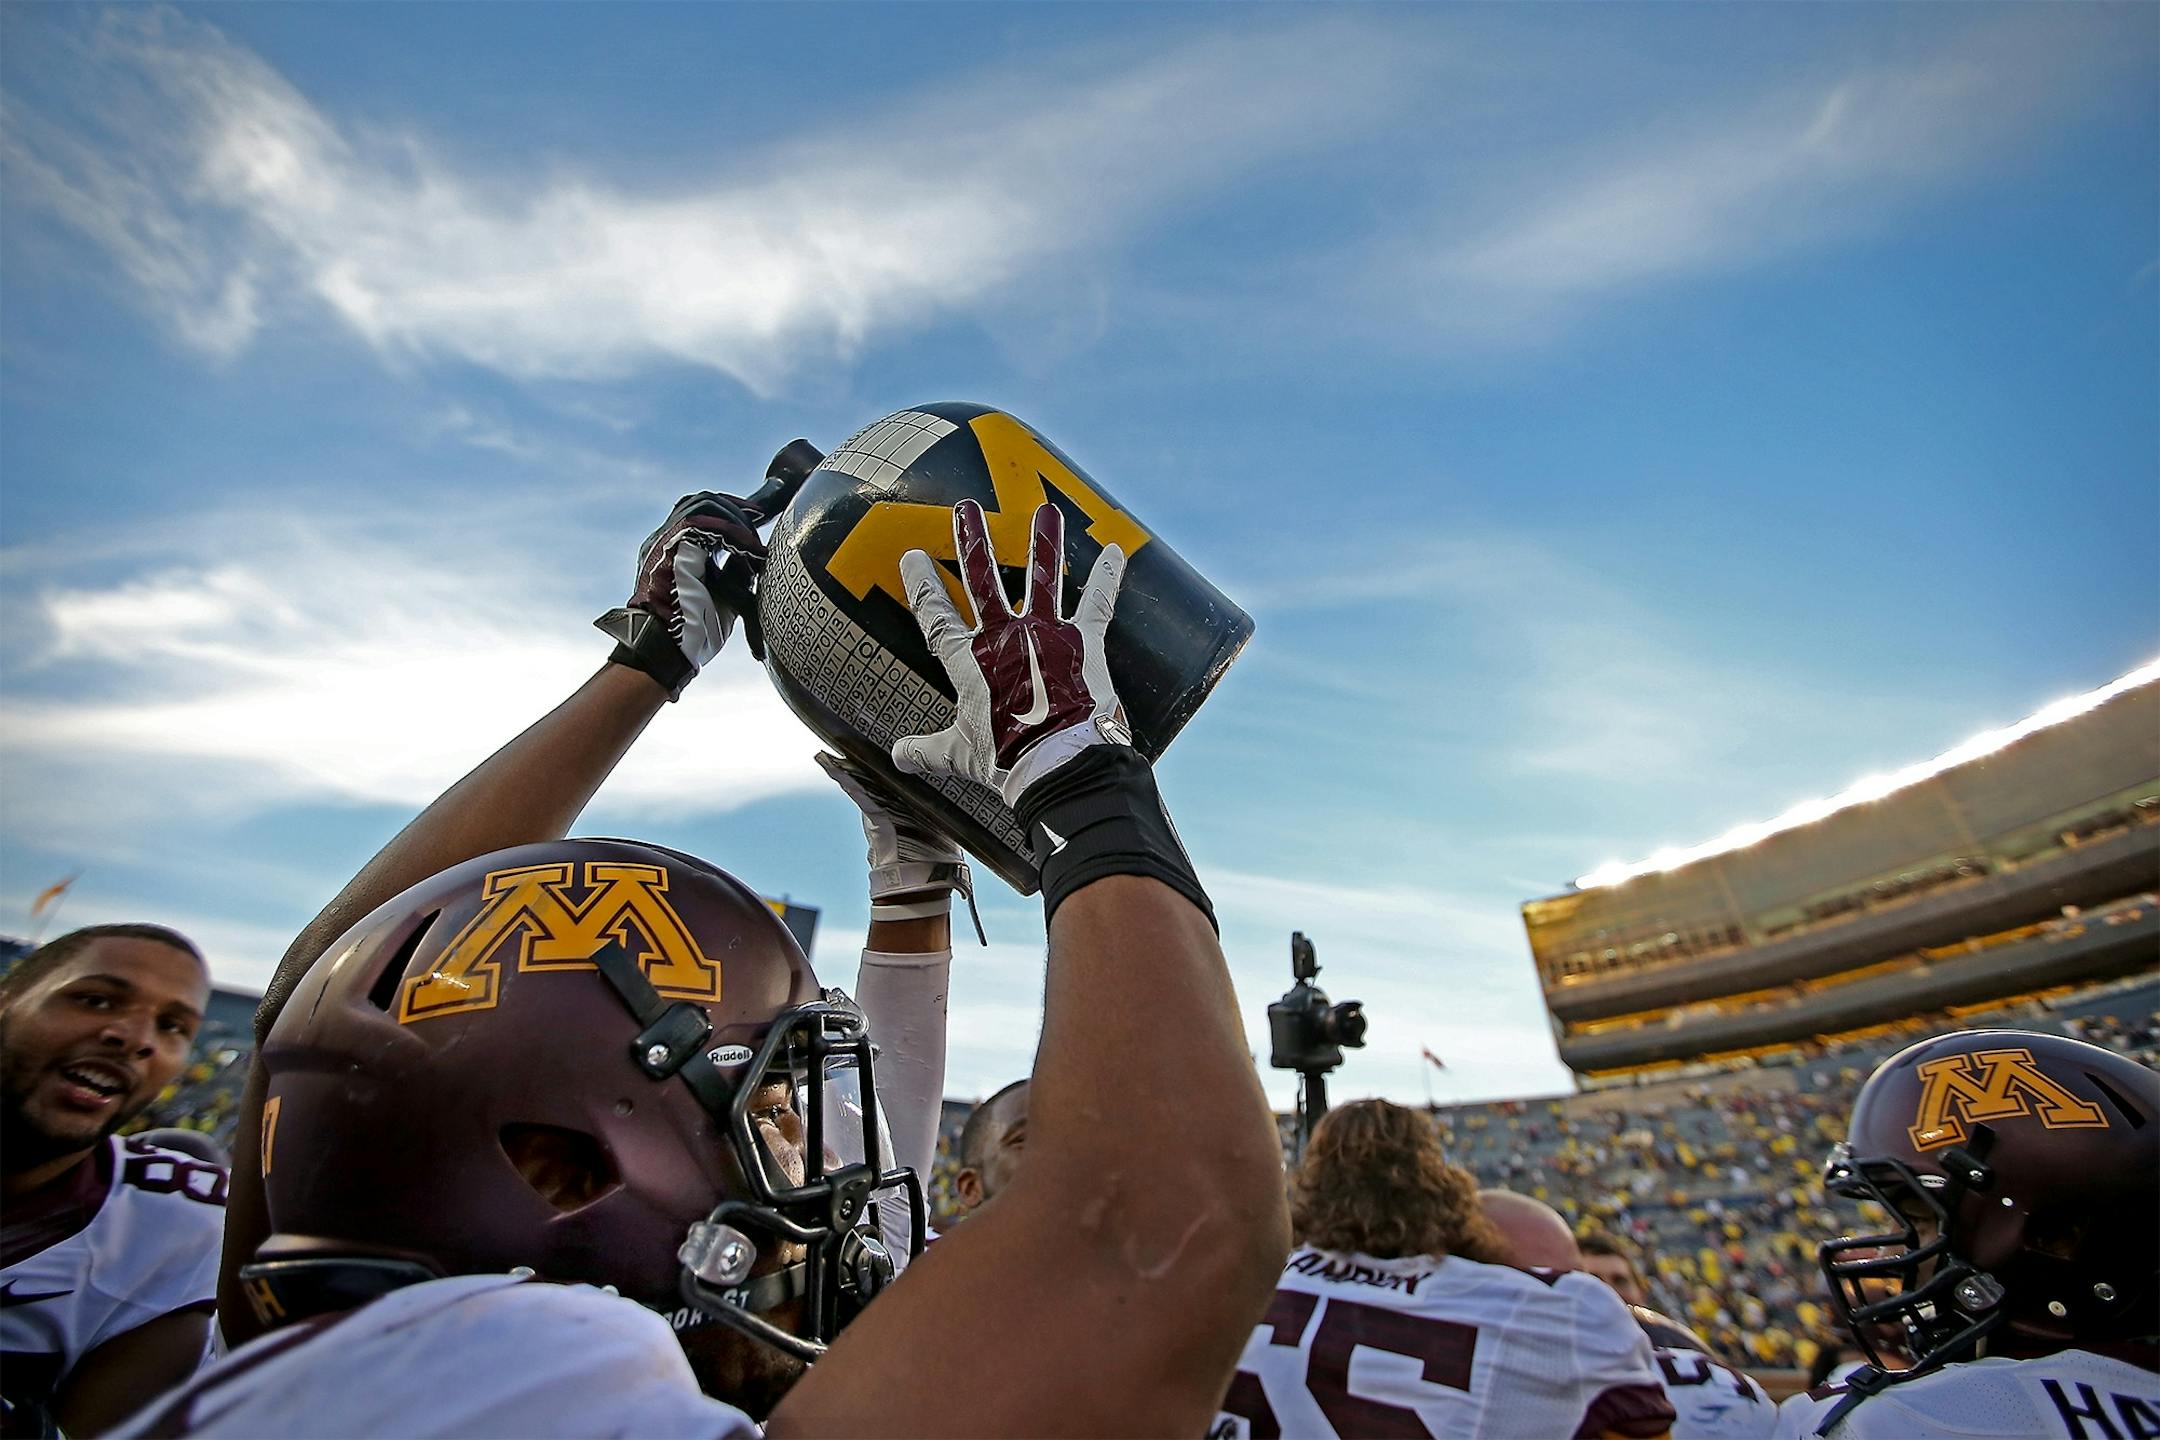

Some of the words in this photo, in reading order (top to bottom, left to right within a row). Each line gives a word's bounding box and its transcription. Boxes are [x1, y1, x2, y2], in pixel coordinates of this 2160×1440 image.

[788, 562, 798, 578] 0
[775, 596, 794, 634] 1967
[793, 575, 809, 595] 20
[784, 613, 805, 648] 1968
[803, 590, 820, 612] 20
[795, 626, 815, 660] 1969
[817, 607, 829, 621] 9
[800, 667, 813, 686] 39
[808, 635, 830, 671] 1970
[828, 619, 844, 636] 13
[859, 641, 873, 658] 0
[874, 654, 887, 669] 7
[813, 682, 828, 700] 35
[821, 653, 843, 685] 1971
[843, 631, 857, 643] 7
[835, 665, 859, 695] 1972
[828, 693, 843, 712] 42
[849, 674, 875, 707] 1973
[856, 717, 871, 733] 49
[865, 688, 887, 717] 1974
[888, 667, 901, 682] 0
[842, 707, 857, 723] 34
[870, 726, 887, 744] 28
[880, 699, 905, 729] 1975
[902, 677, 920, 698] 21
[895, 710, 921, 737] 1976
[918, 690, 933, 706] 0
[931, 703, 948, 721] 16
[945, 785, 961, 800] 37
[977, 808, 993, 824] 52
[993, 822, 1008, 837] 58
[1006, 834, 1020, 848] 31
[399, 861, 722, 1024] M
[711, 1049, 750, 1063] Riddell
[1907, 1048, 2110, 1152] M
[2040, 1379, 2160, 1440] HA
